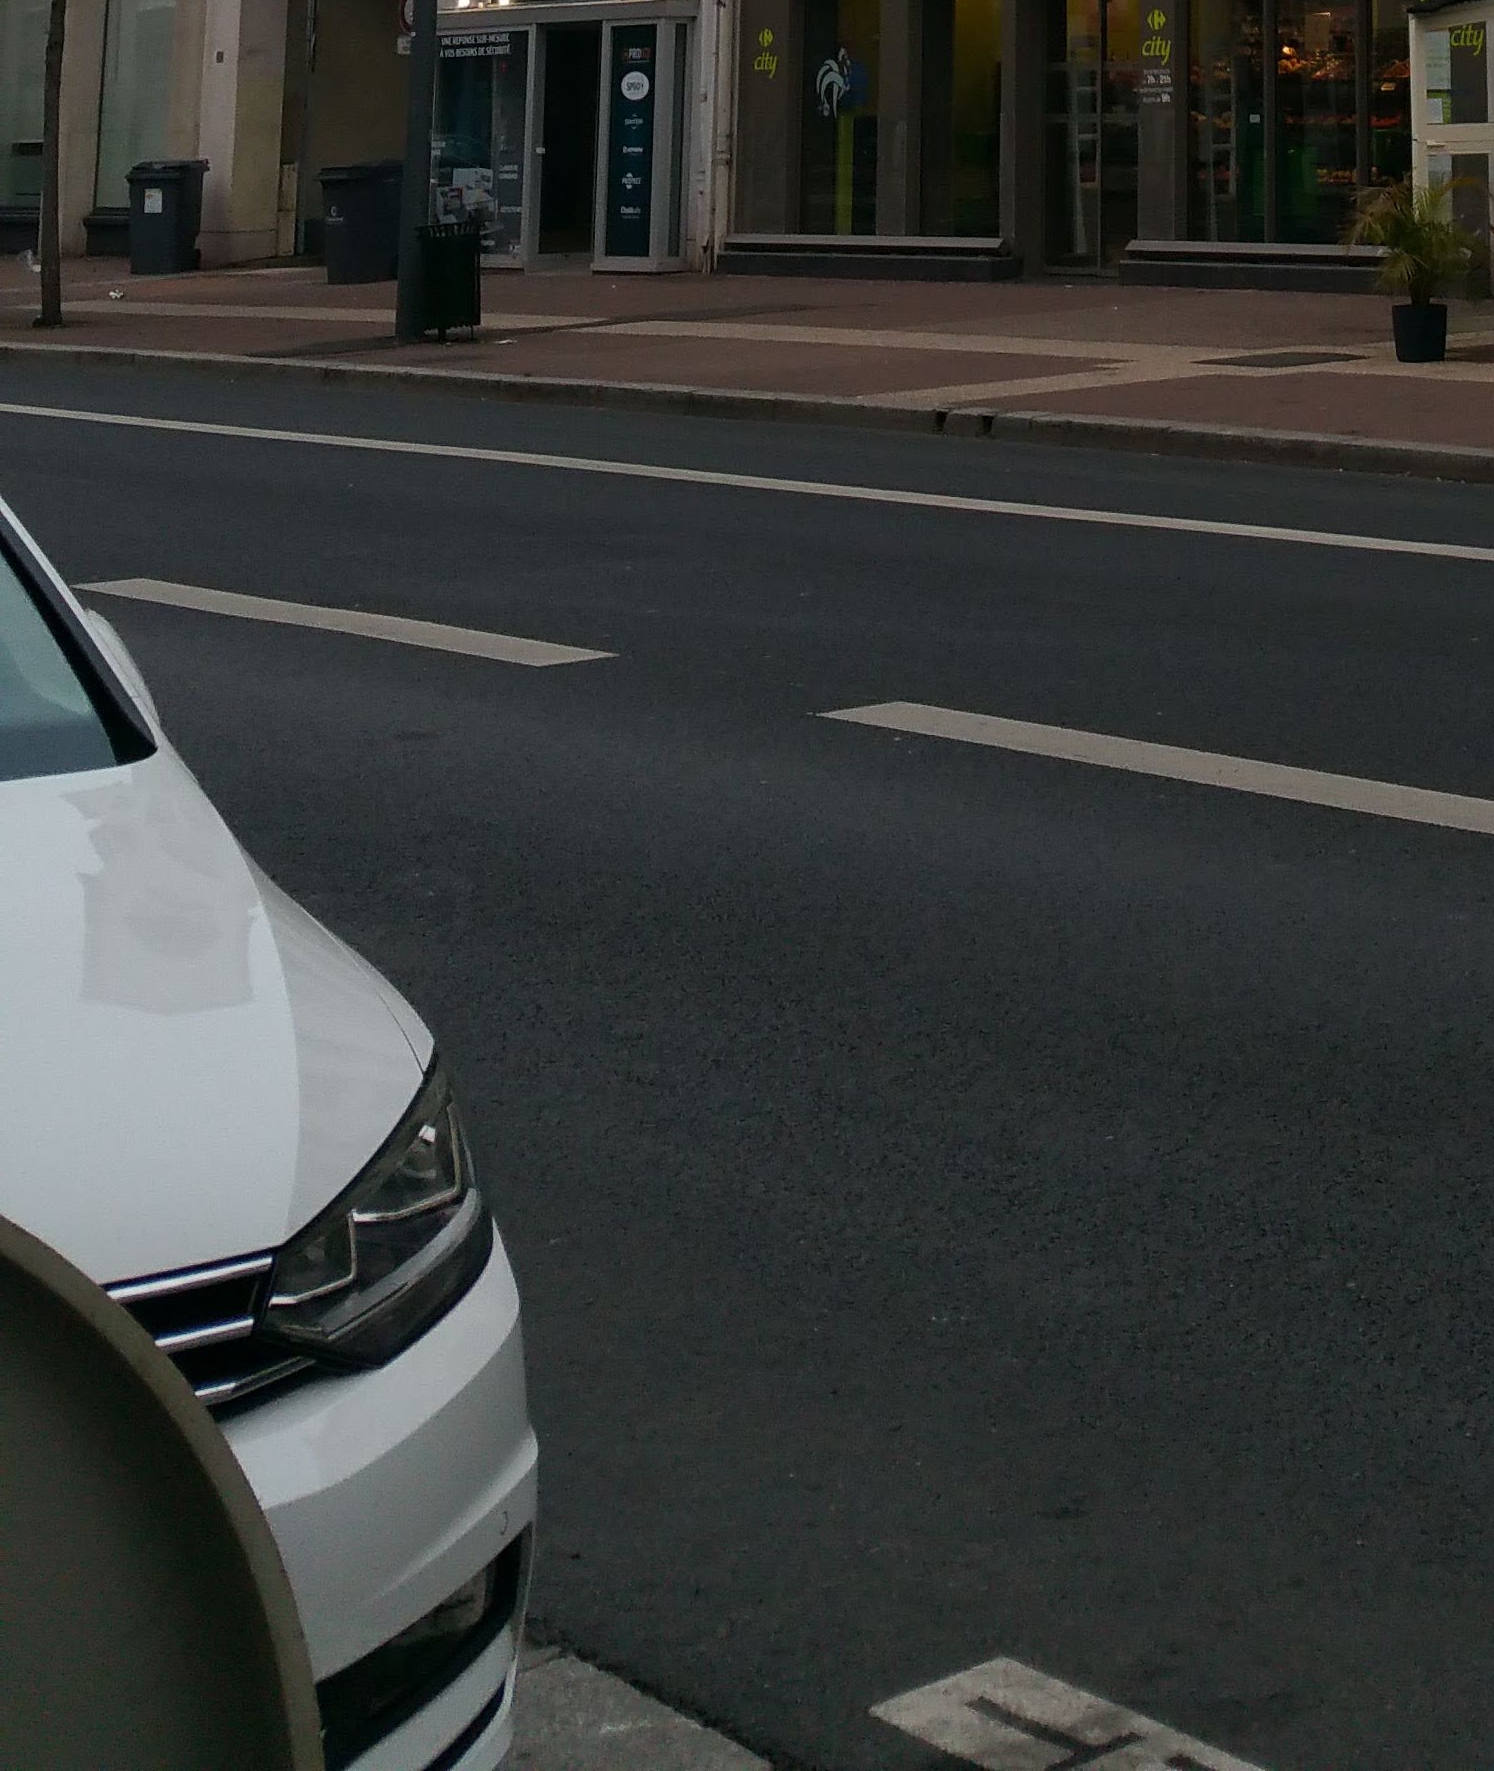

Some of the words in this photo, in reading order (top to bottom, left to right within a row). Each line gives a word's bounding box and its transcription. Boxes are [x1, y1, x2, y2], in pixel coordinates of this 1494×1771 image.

[1141, 35, 1172, 66] city
[1450, 24, 1485, 56] city
[753, 52, 778, 79] city
